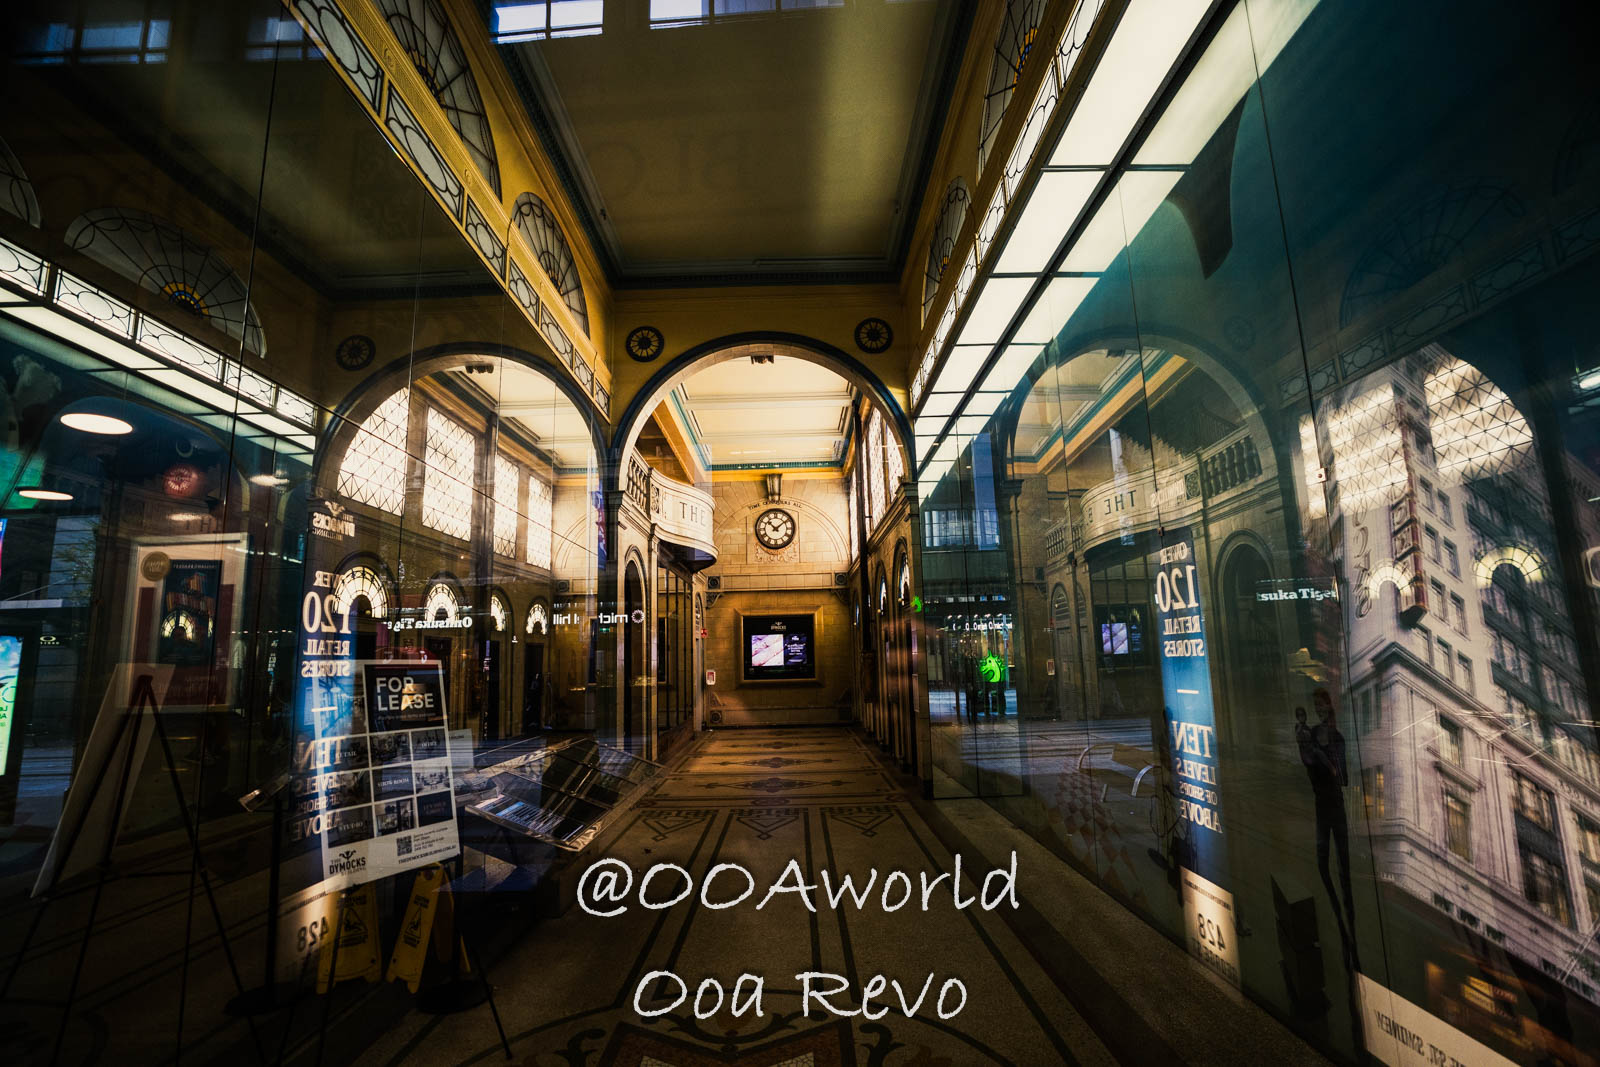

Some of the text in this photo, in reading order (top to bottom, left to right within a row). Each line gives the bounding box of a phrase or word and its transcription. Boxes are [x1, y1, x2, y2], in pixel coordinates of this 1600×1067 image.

[679, 501, 706, 527] THE
[375, 676, 415, 693] FOR
[377, 692, 435, 712] LEASE
[329, 856, 366, 875] DYMOCKS
